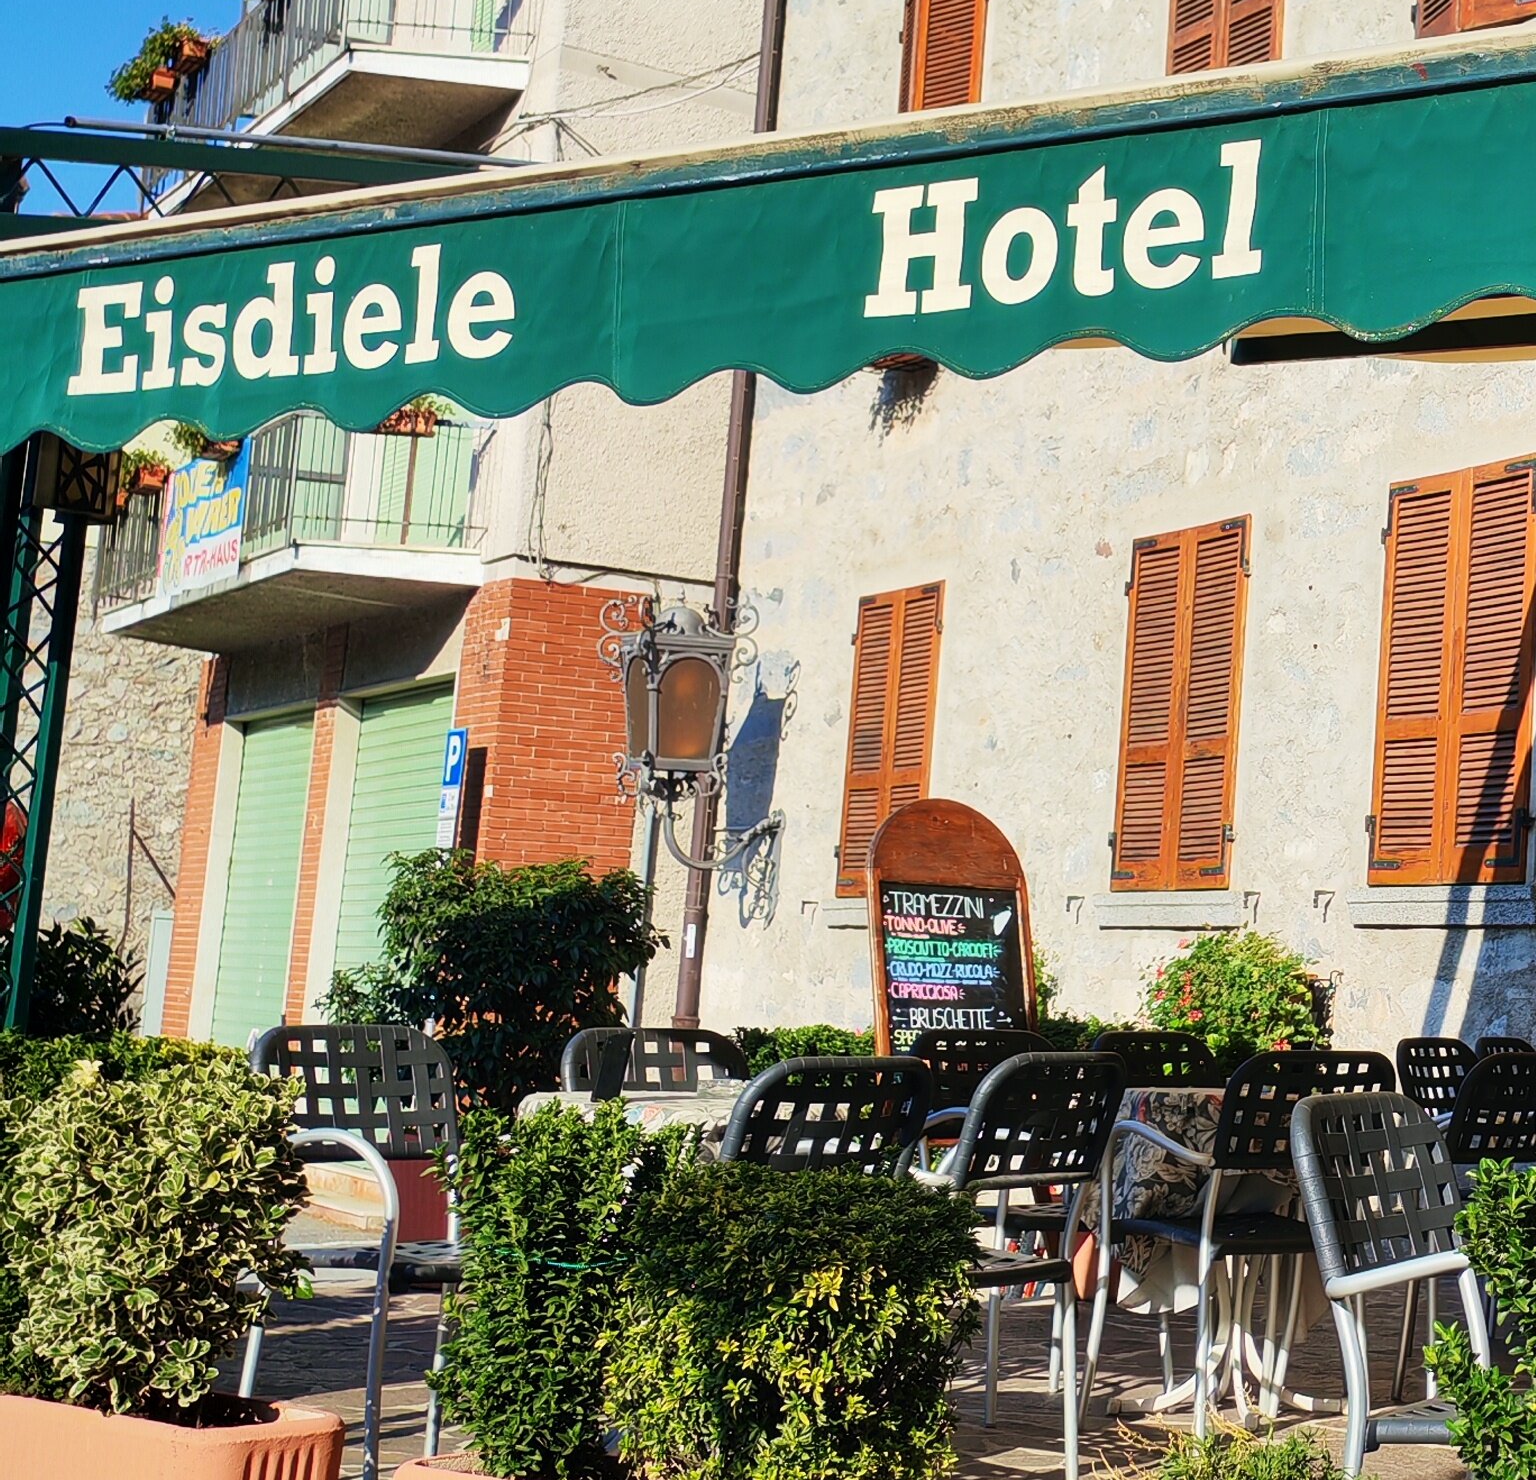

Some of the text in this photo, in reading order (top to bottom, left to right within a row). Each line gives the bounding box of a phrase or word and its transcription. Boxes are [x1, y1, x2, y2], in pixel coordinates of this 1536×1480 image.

[67, 139, 1261, 395] Eisdiele Hotel
[445, 735, 462, 782] P
[888, 891, 985, 919] TRAMEZZINI
[884, 915, 959, 936] TONNO-OLIVE
[890, 981, 959, 1001] CAPRICCIOSA
[909, 1006, 996, 1030] BRUSCHETTE
